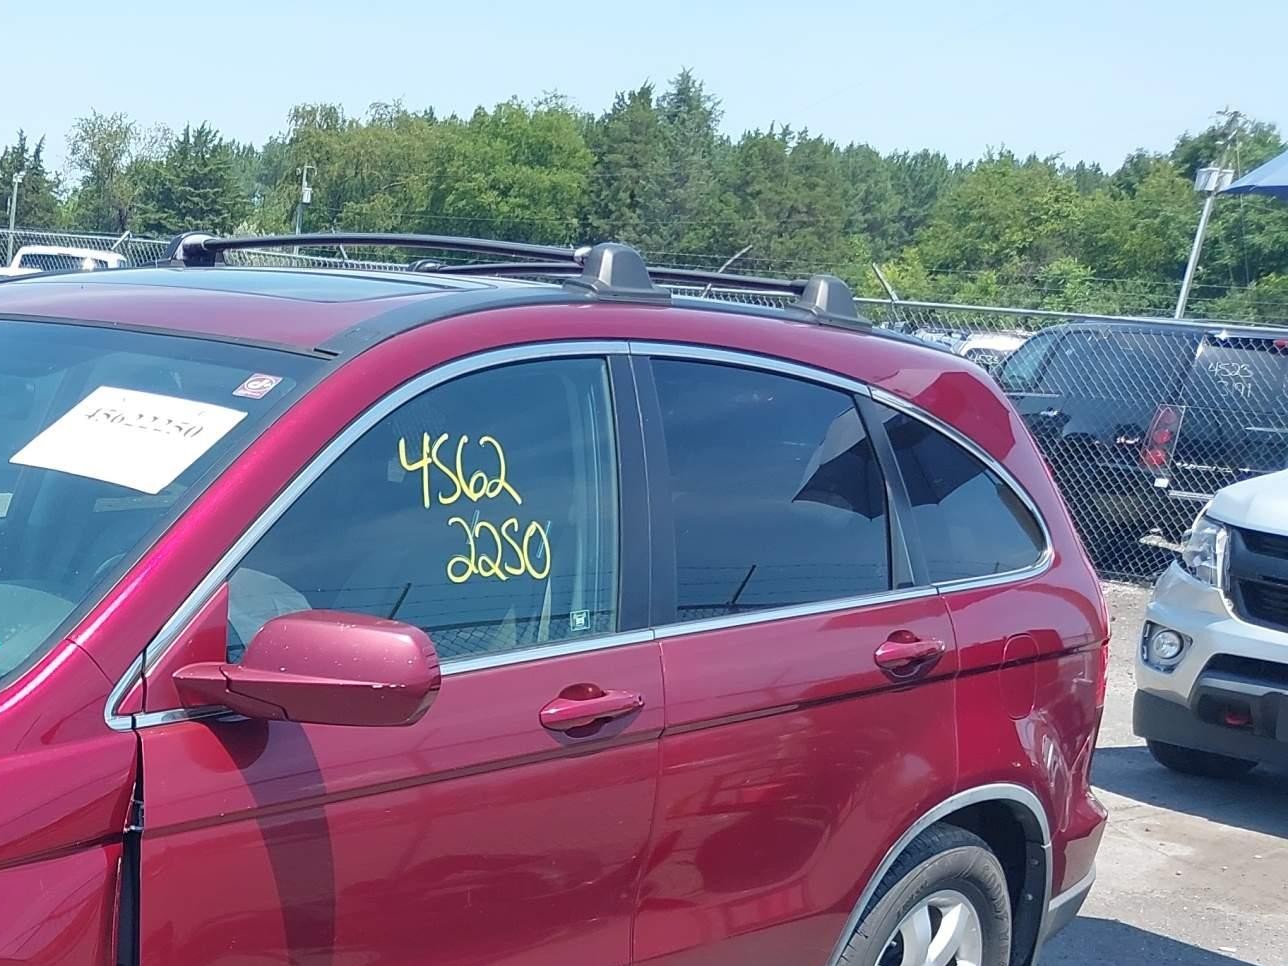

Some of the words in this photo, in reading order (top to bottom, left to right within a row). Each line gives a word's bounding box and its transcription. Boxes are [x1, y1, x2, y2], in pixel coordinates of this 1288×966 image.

[1208, 361, 1253, 378] 4523
[398, 432, 523, 509] 4562
[446, 516, 552, 583] 2250
